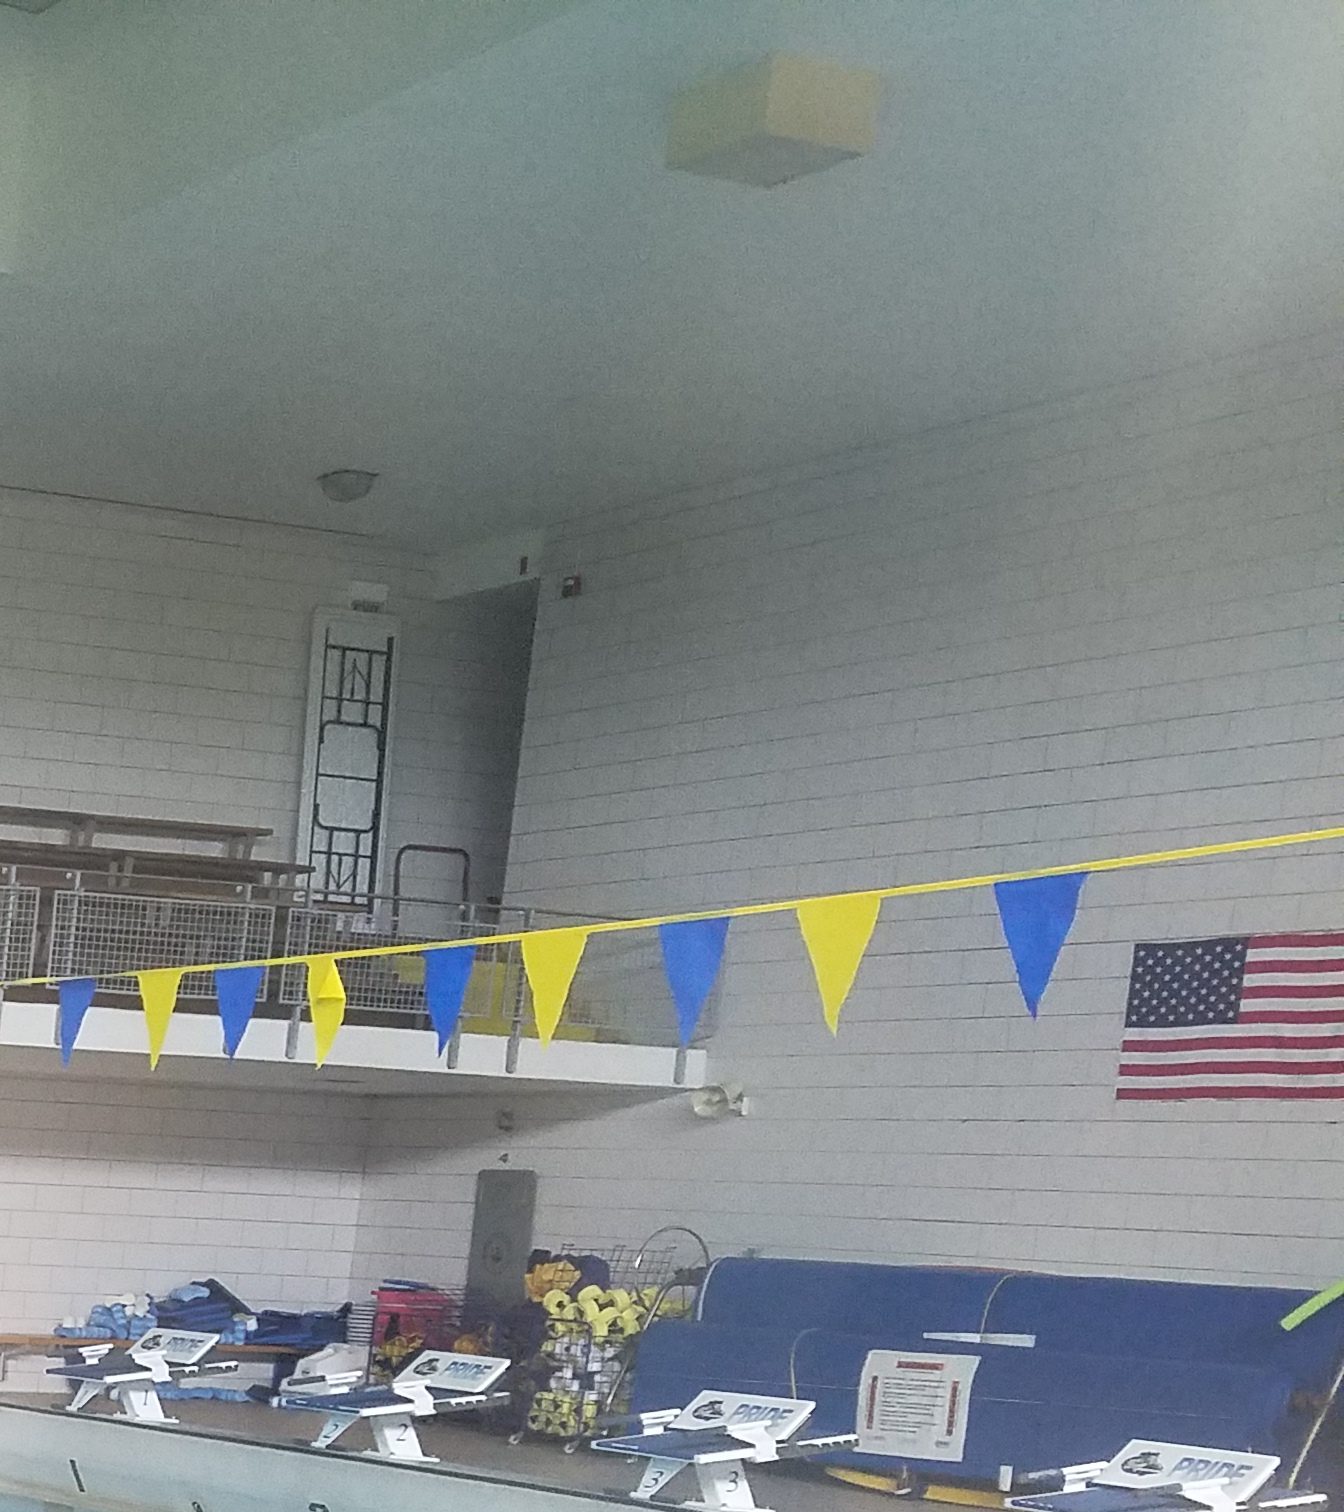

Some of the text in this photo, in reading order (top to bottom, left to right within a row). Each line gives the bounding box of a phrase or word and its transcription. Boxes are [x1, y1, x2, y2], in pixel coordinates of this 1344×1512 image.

[729, 1403, 795, 1424] PRIDE
[323, 1422, 339, 1439] 2
[396, 1423, 409, 1442] 2
[1169, 1456, 1255, 1480] PRIDE
[644, 1470, 665, 1489] 3
[725, 1470, 740, 1493] 3
